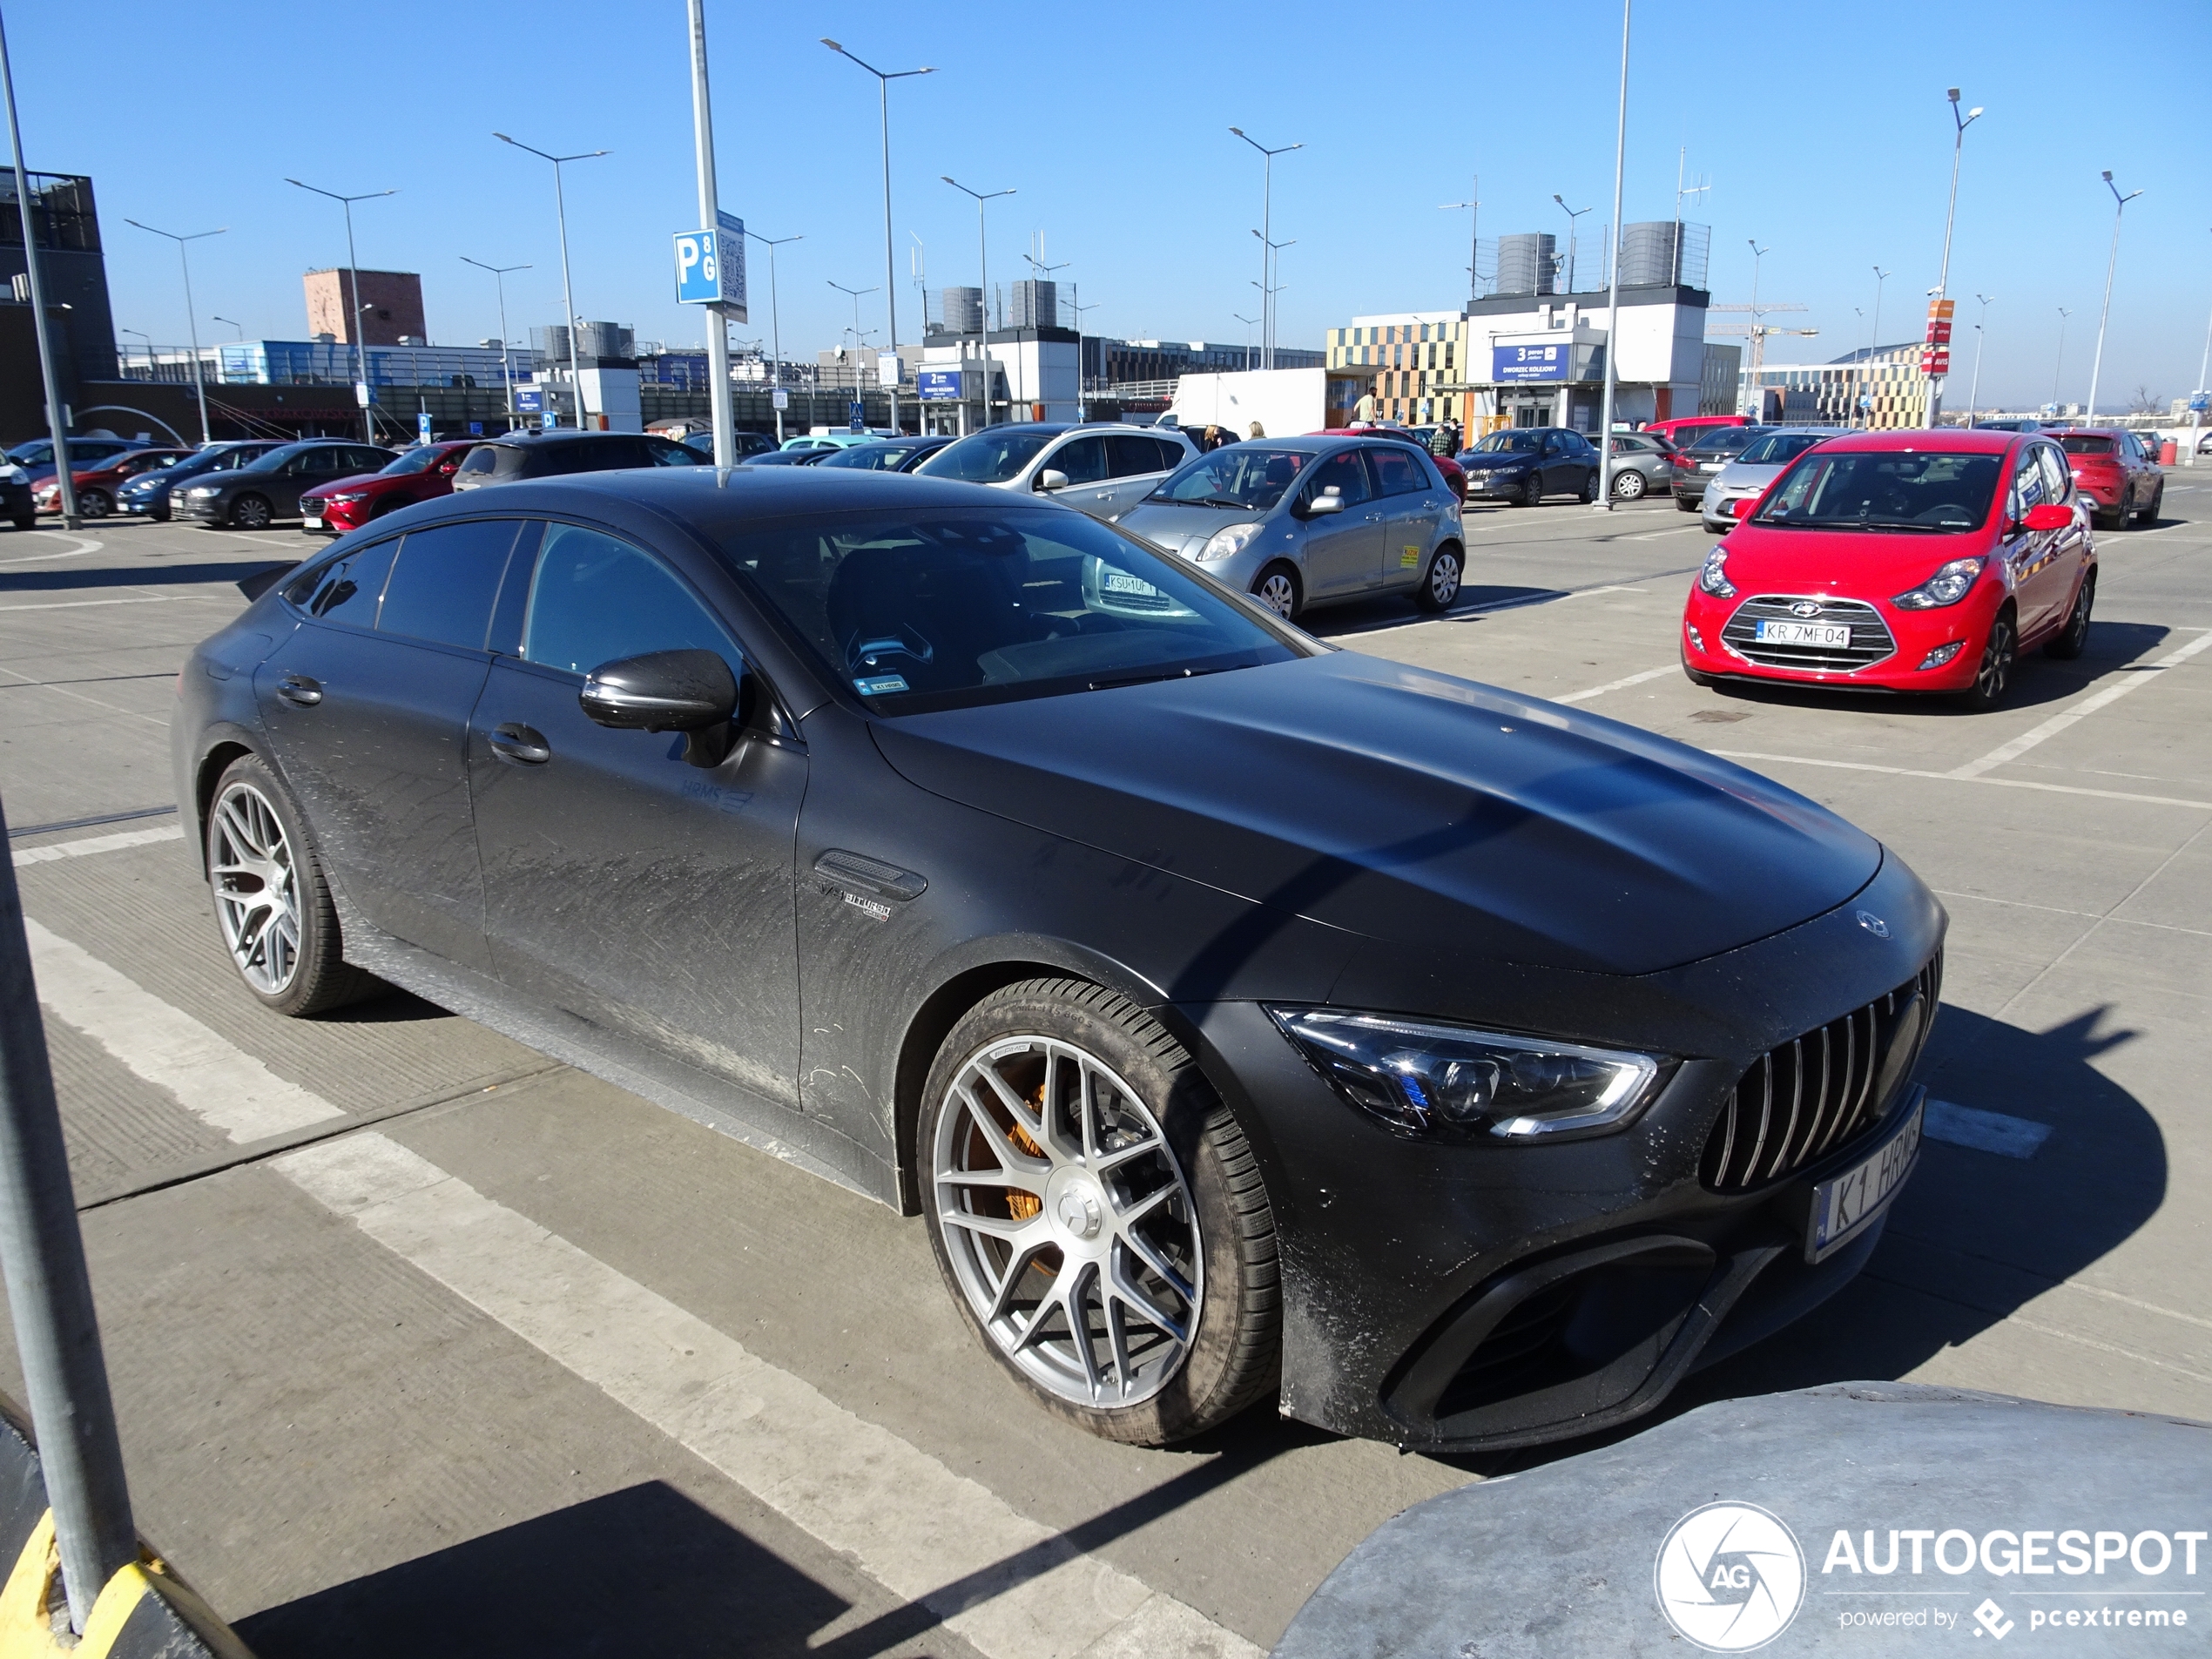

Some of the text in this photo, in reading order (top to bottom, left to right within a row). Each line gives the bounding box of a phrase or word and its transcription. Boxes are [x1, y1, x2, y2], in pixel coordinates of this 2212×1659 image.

[703, 235, 711, 253] 8
[676, 237, 699, 285] P
[703, 255, 716, 281] G
[1517, 347, 1526, 361] 3
[931, 373, 937, 384] 2
[420, 415, 429, 431] P
[544, 414, 552, 426] P
[1110, 577, 1128, 589] KSU
[1767, 624, 1845, 644] KR 7MF04
[846, 894, 891, 915] BITURBO
[1063, 1011, 1085, 1025] 860
[1086, 1019, 1094, 1028] S
[1004, 1044, 1028, 1054] AMG
[1836, 1164, 1869, 1232] K1
